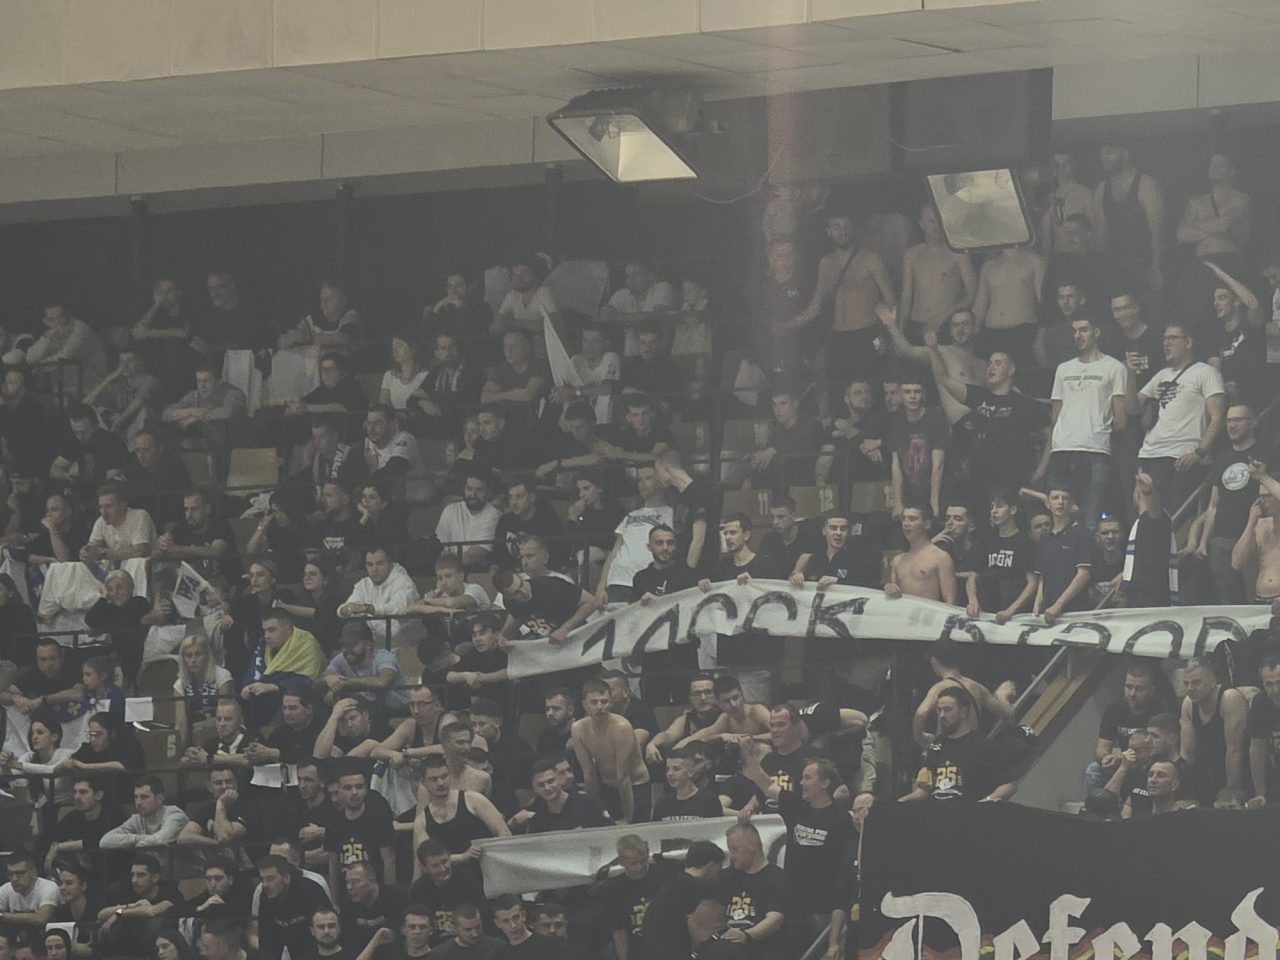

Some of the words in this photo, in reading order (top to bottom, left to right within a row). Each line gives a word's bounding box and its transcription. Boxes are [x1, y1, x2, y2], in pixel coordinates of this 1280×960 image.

[819, 489, 834, 513] 12
[937, 767, 957, 788] 25
[342, 843, 363, 864] 25
